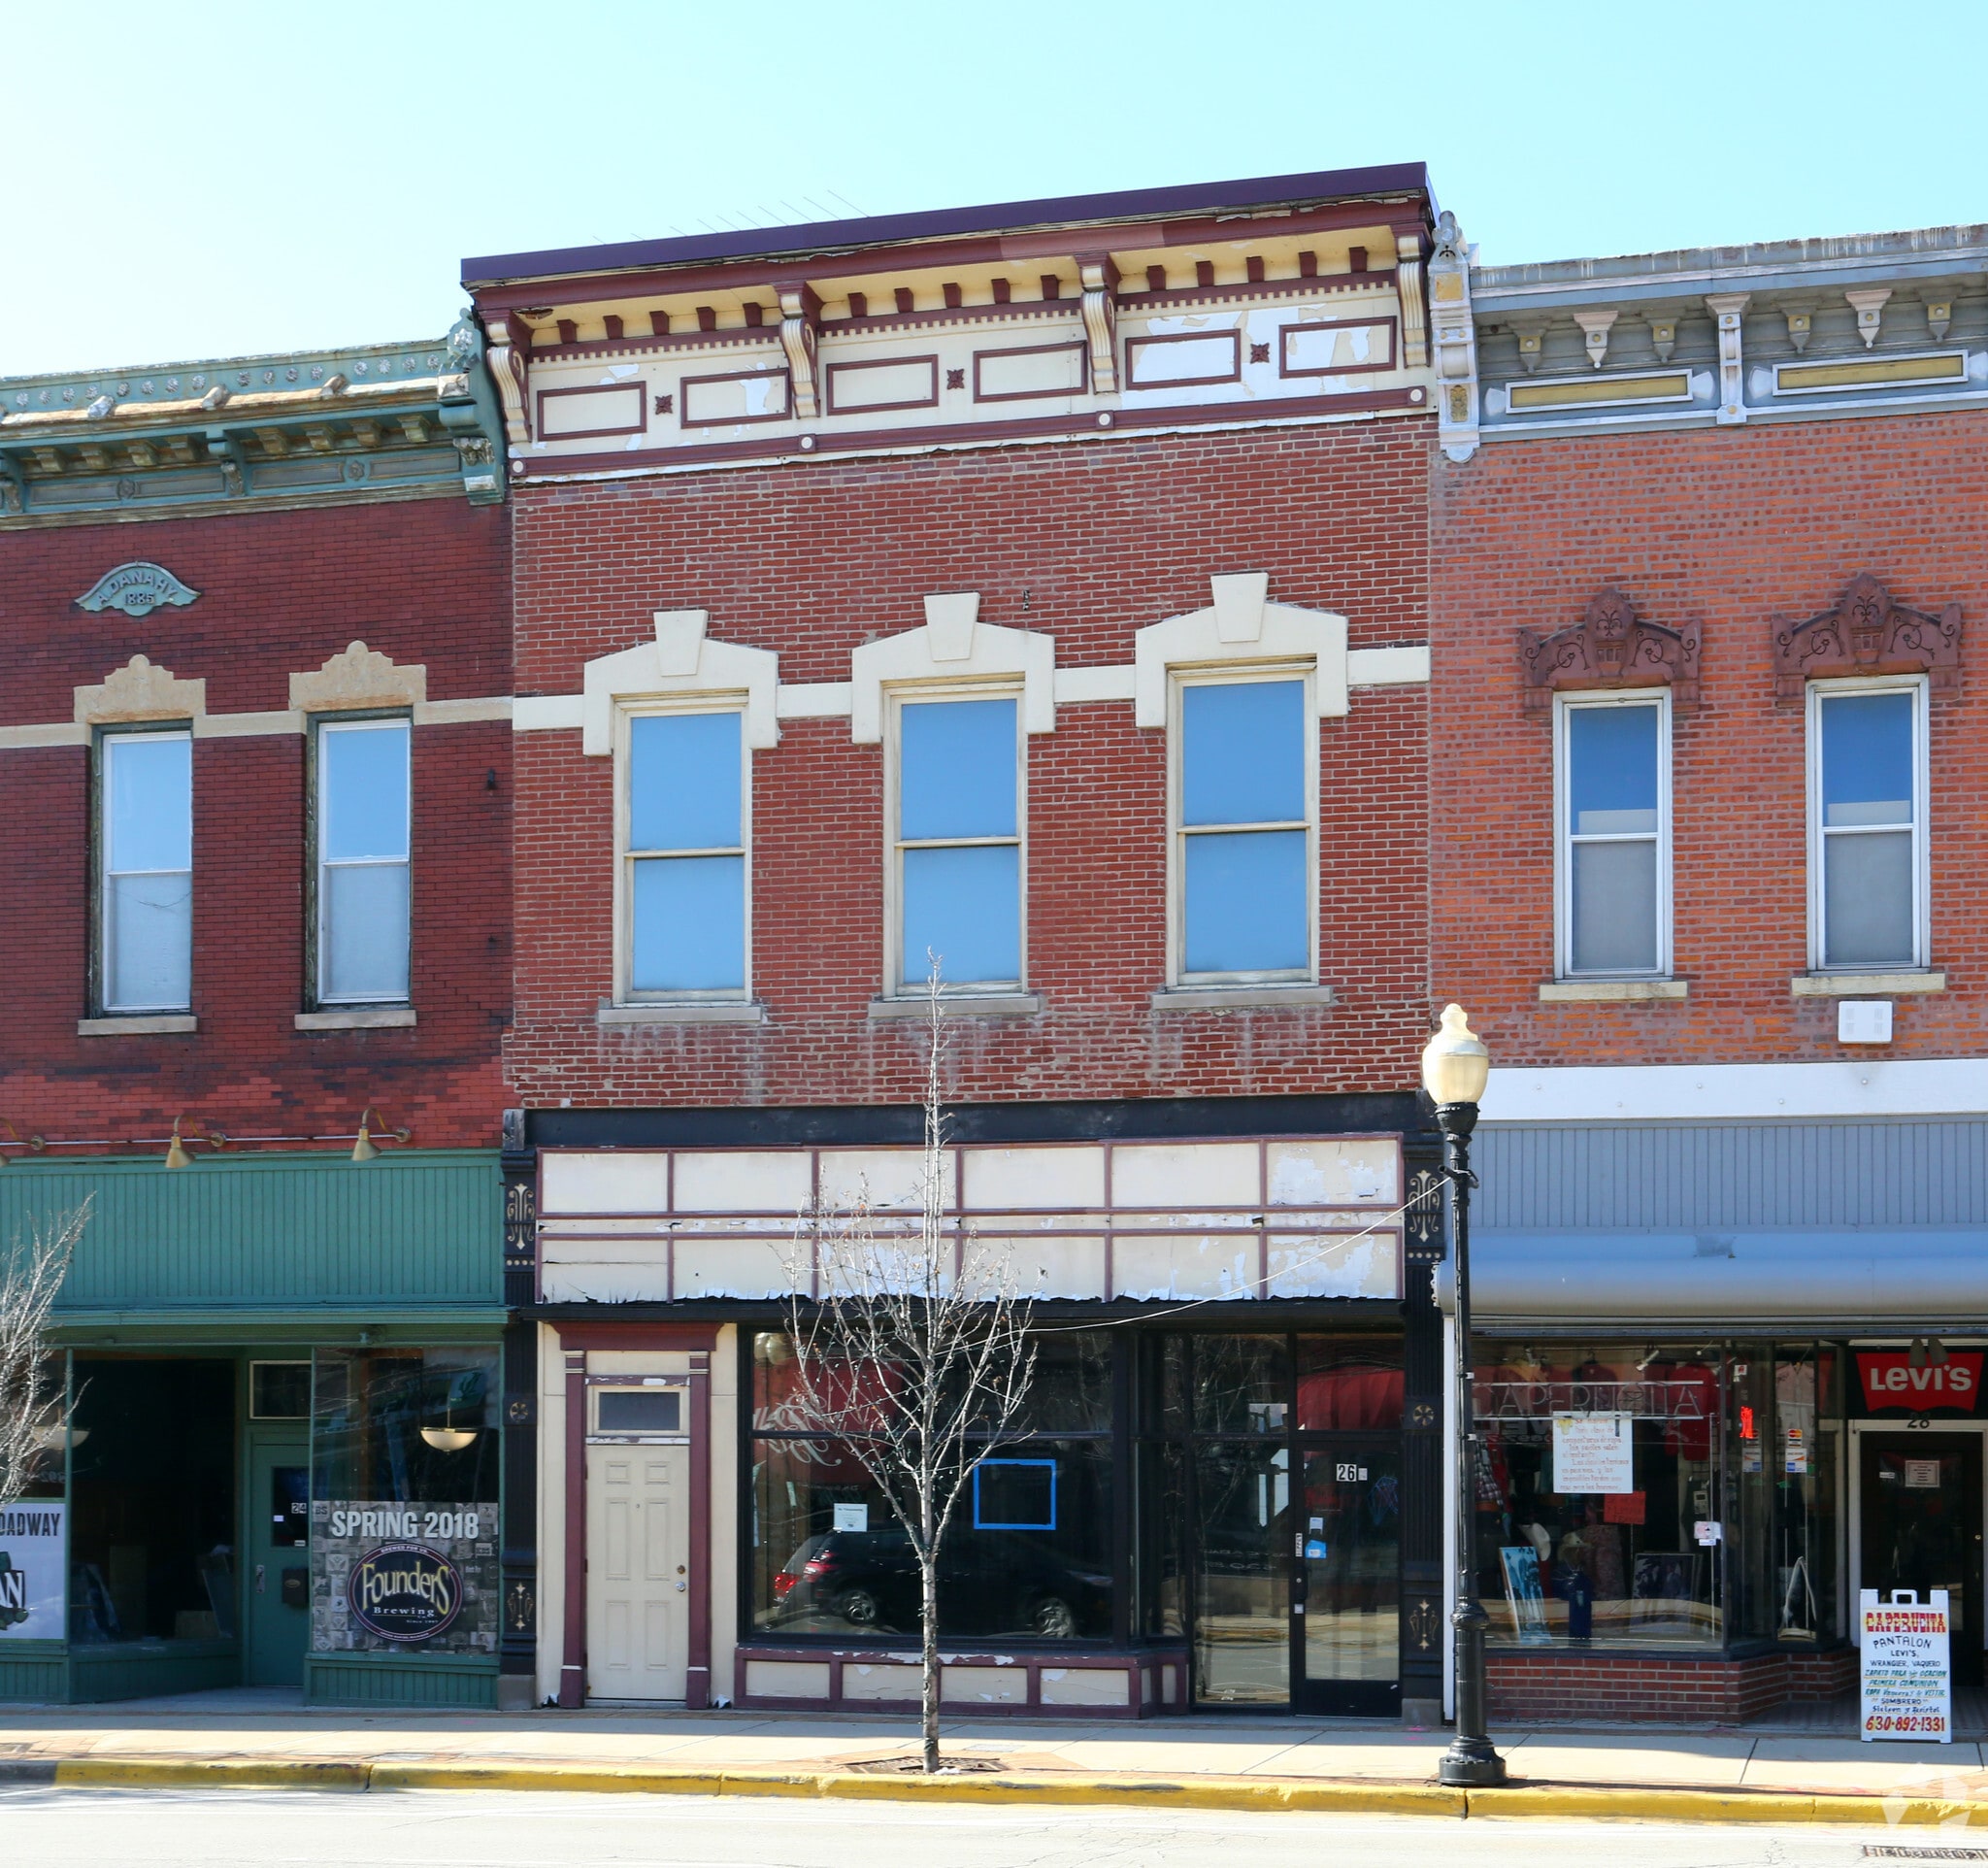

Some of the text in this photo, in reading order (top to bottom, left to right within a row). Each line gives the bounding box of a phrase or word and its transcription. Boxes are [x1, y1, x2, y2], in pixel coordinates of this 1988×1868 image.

[111, 571, 178, 598] DANAHY
[125, 592, 155, 605] 1885
[1906, 1412, 1930, 1429] 28
[1338, 1465, 1356, 1481] 26
[292, 1503, 307, 1514] 24
[331, 1511, 480, 1539] SPRING 2018
[361, 1560, 449, 1615] Founders
[373, 1606, 435, 1618] Brewing
[1866, 1612, 1946, 1632] CAPERUCITA
[1872, 1635, 1932, 1649] PANTALON
